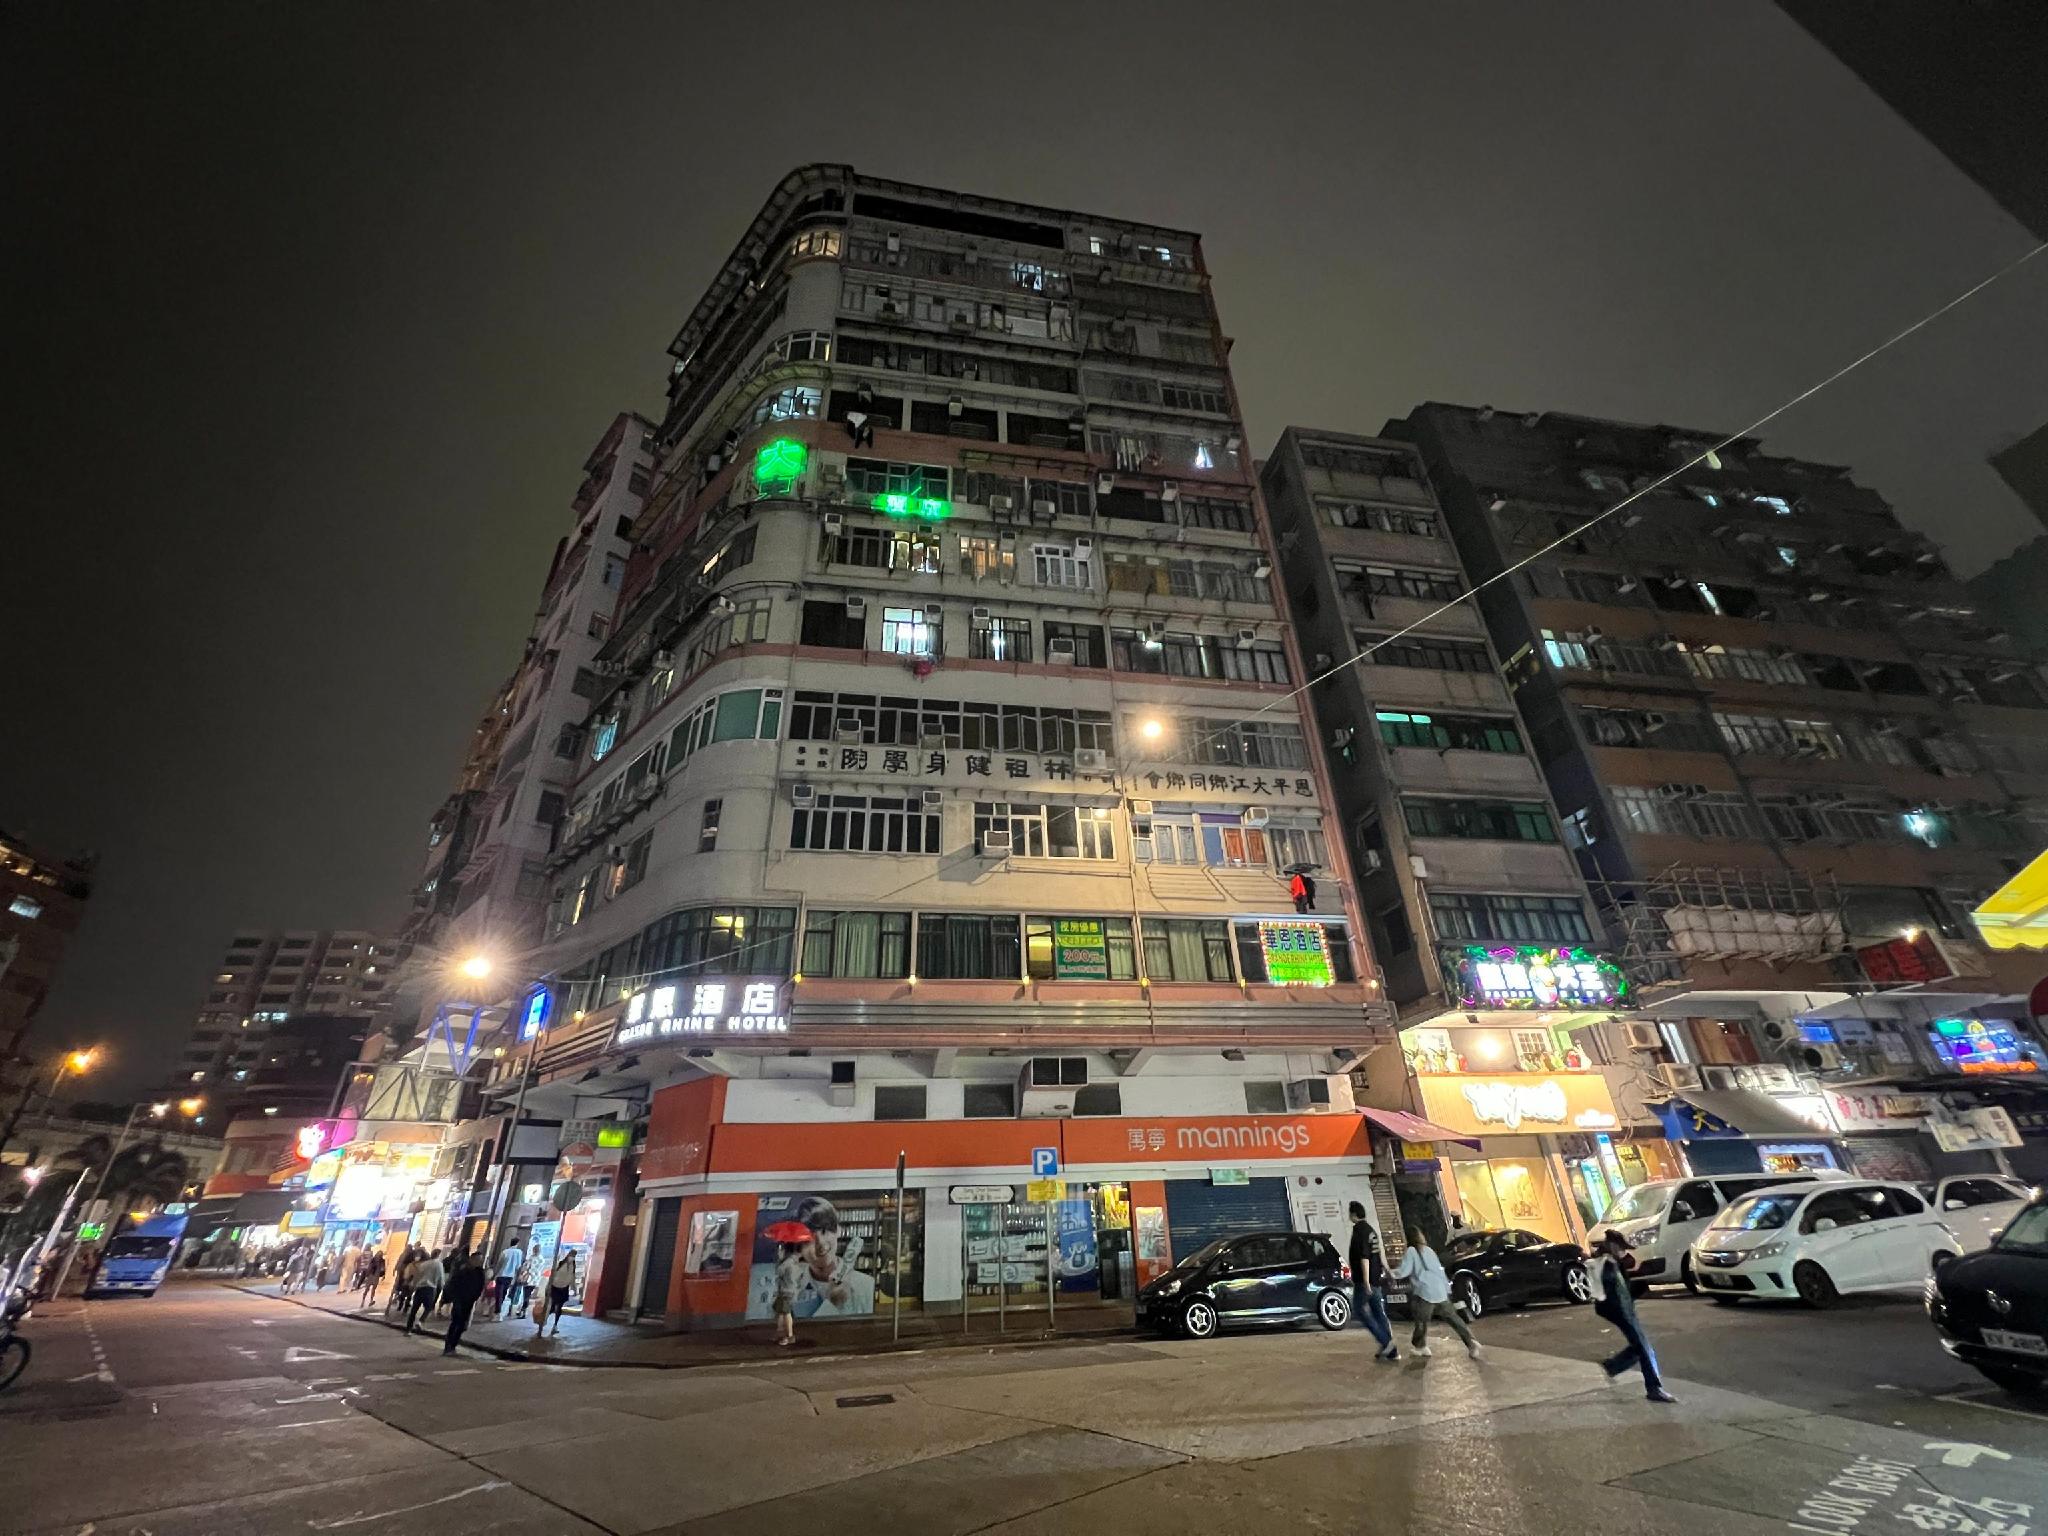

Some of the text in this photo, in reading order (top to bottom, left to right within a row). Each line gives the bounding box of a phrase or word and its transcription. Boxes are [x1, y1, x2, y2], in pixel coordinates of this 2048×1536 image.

[1263, 928, 1322, 951] 華恩酒店
[659, 1015, 715, 1034] RHINE
[727, 1015, 788, 1033] HOTEL
[1177, 1119, 1311, 1154] mannings
[1036, 1150, 1054, 1174] P
[1787, 1453, 1917, 1536] LOOK RIGHT
